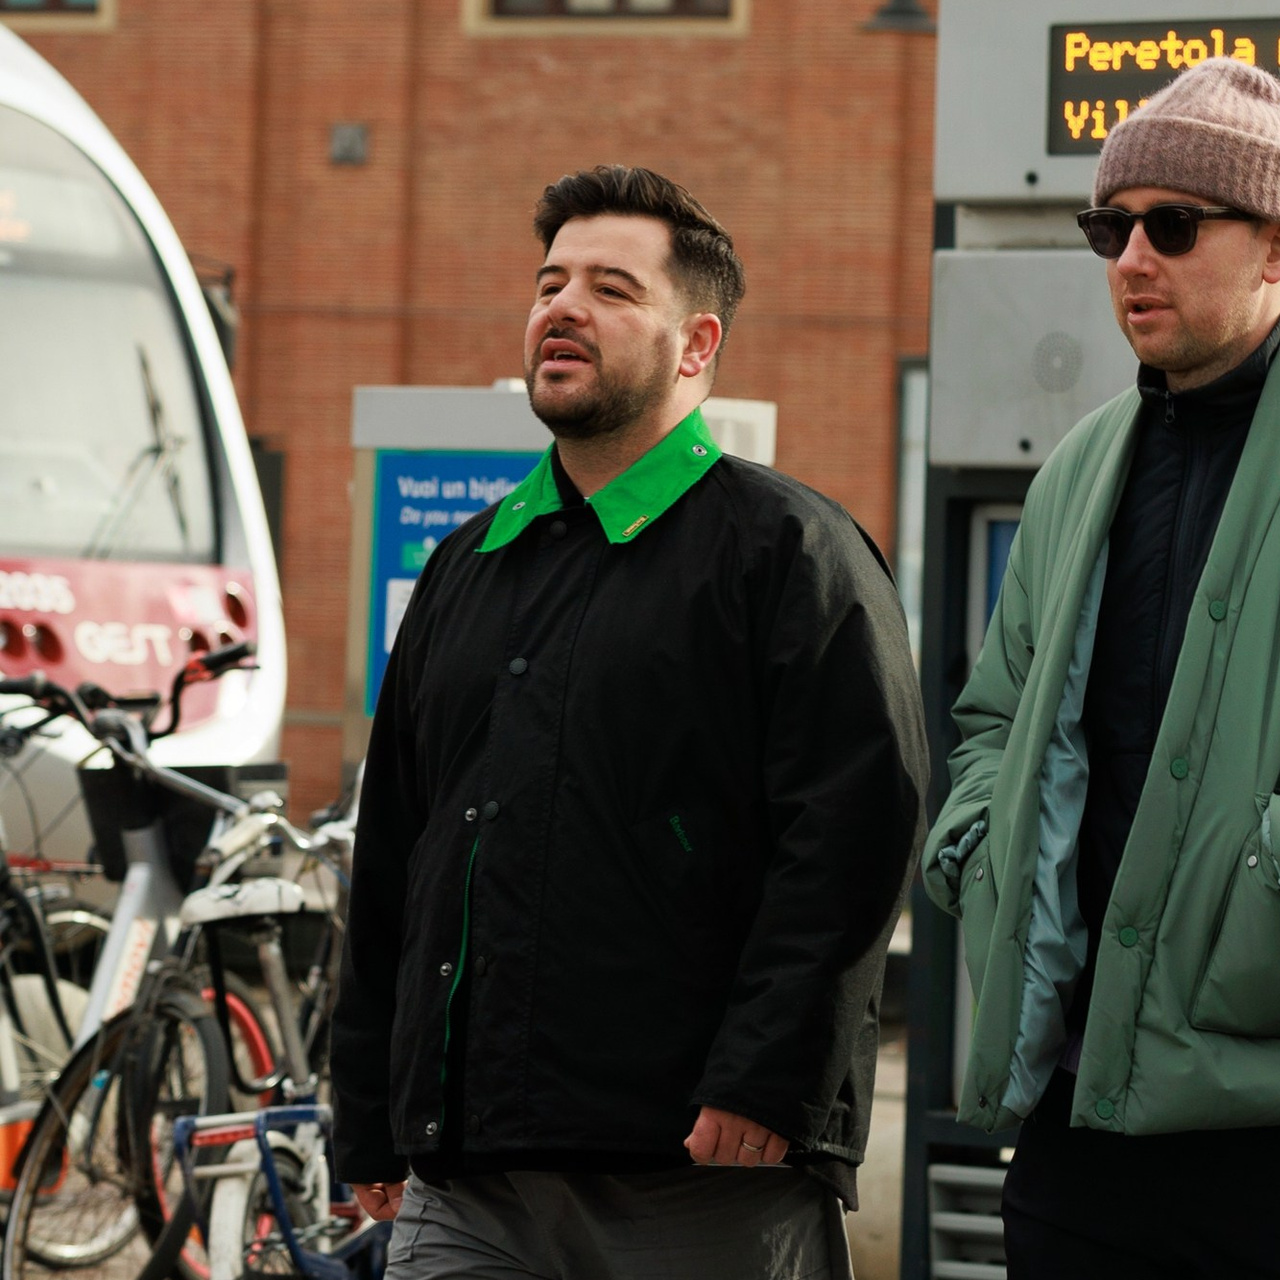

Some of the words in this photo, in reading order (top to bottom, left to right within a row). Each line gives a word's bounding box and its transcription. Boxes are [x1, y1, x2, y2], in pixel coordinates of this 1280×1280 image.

[1065, 28, 1256, 71] Peretola
[1063, 99, 1150, 140] Vil
[442, 480, 466, 499] un
